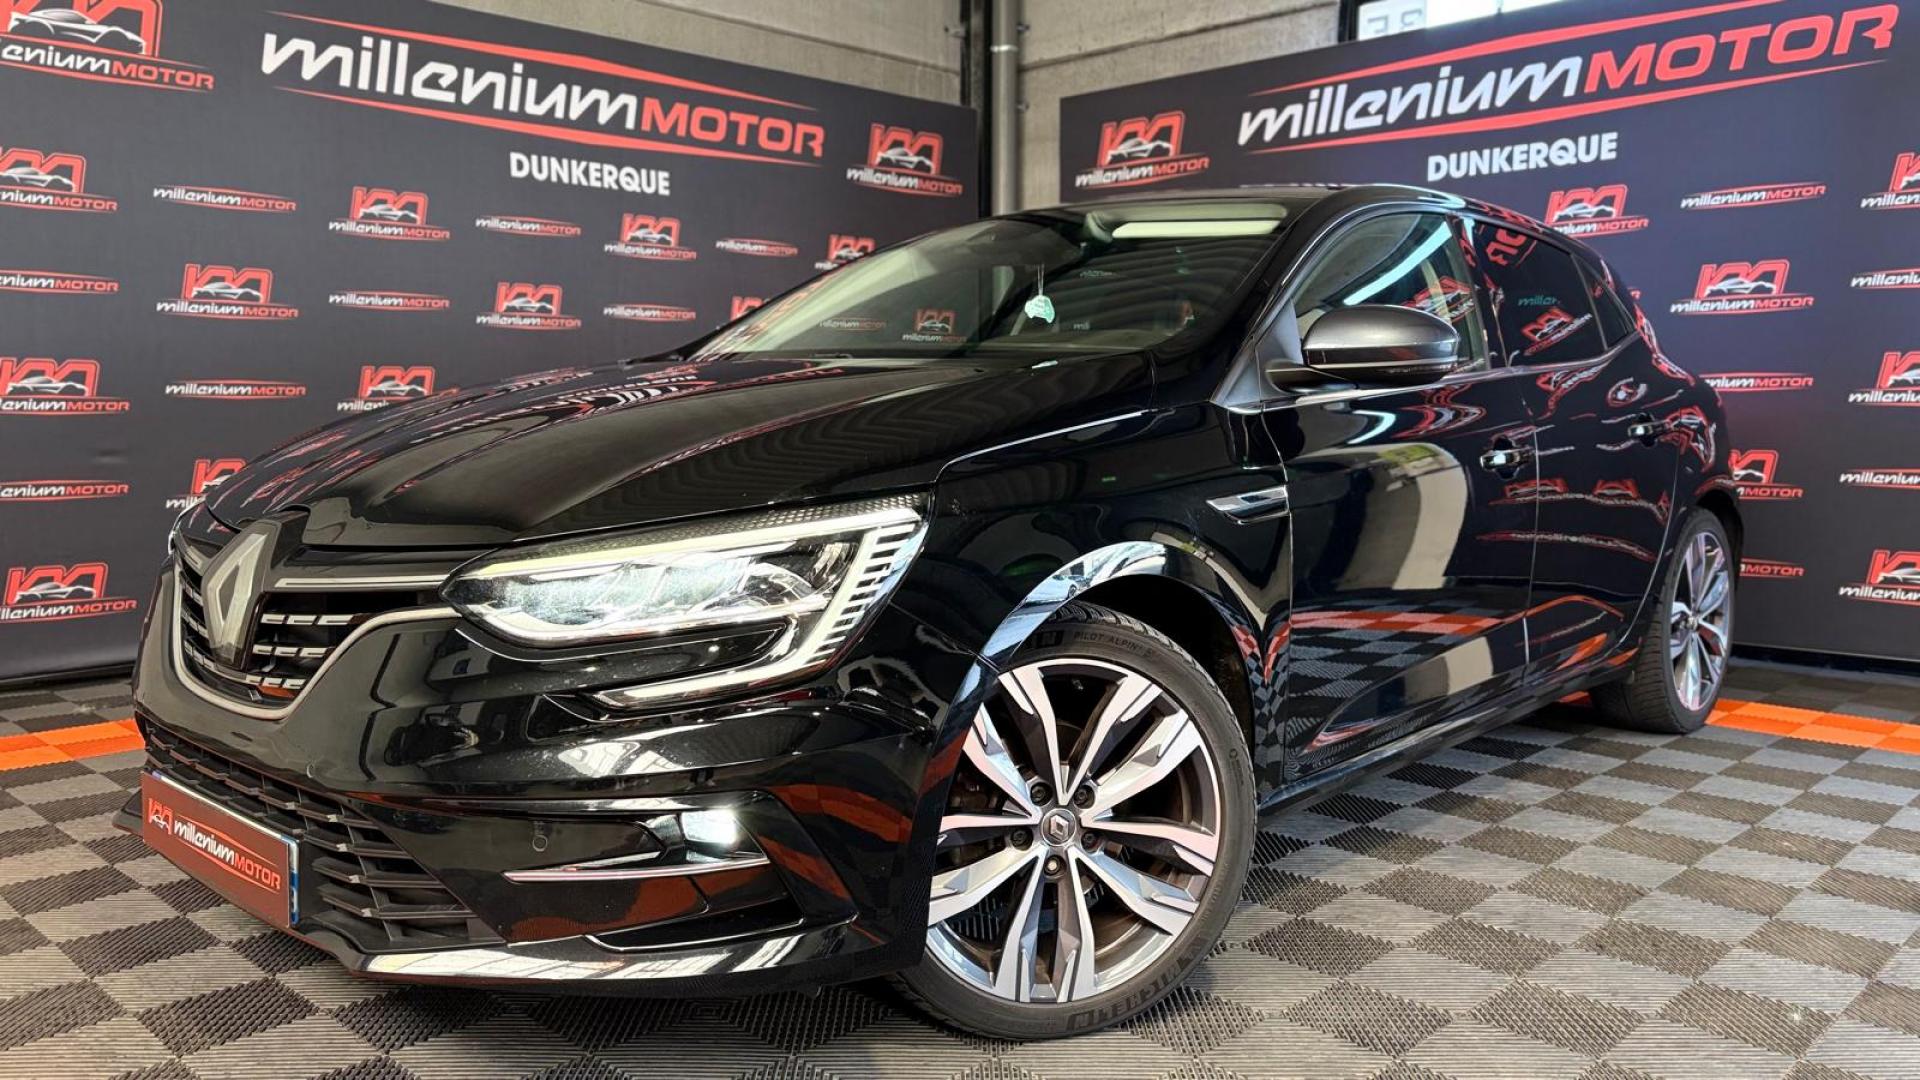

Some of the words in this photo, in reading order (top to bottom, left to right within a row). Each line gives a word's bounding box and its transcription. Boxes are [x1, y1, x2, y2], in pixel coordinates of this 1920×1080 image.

[0, 41, 215, 89] eniumMOTOR
[1427, 132, 1618, 183] DUNKERQUE
[509, 151, 671, 196] DUNKERQUE
[0, 189, 118, 211] niumMOTOR
[0, 275, 119, 291] niumMOTOR
[0, 398, 130, 411] eniumMOTOR
[0, 484, 129, 497] eniumMOTOR
